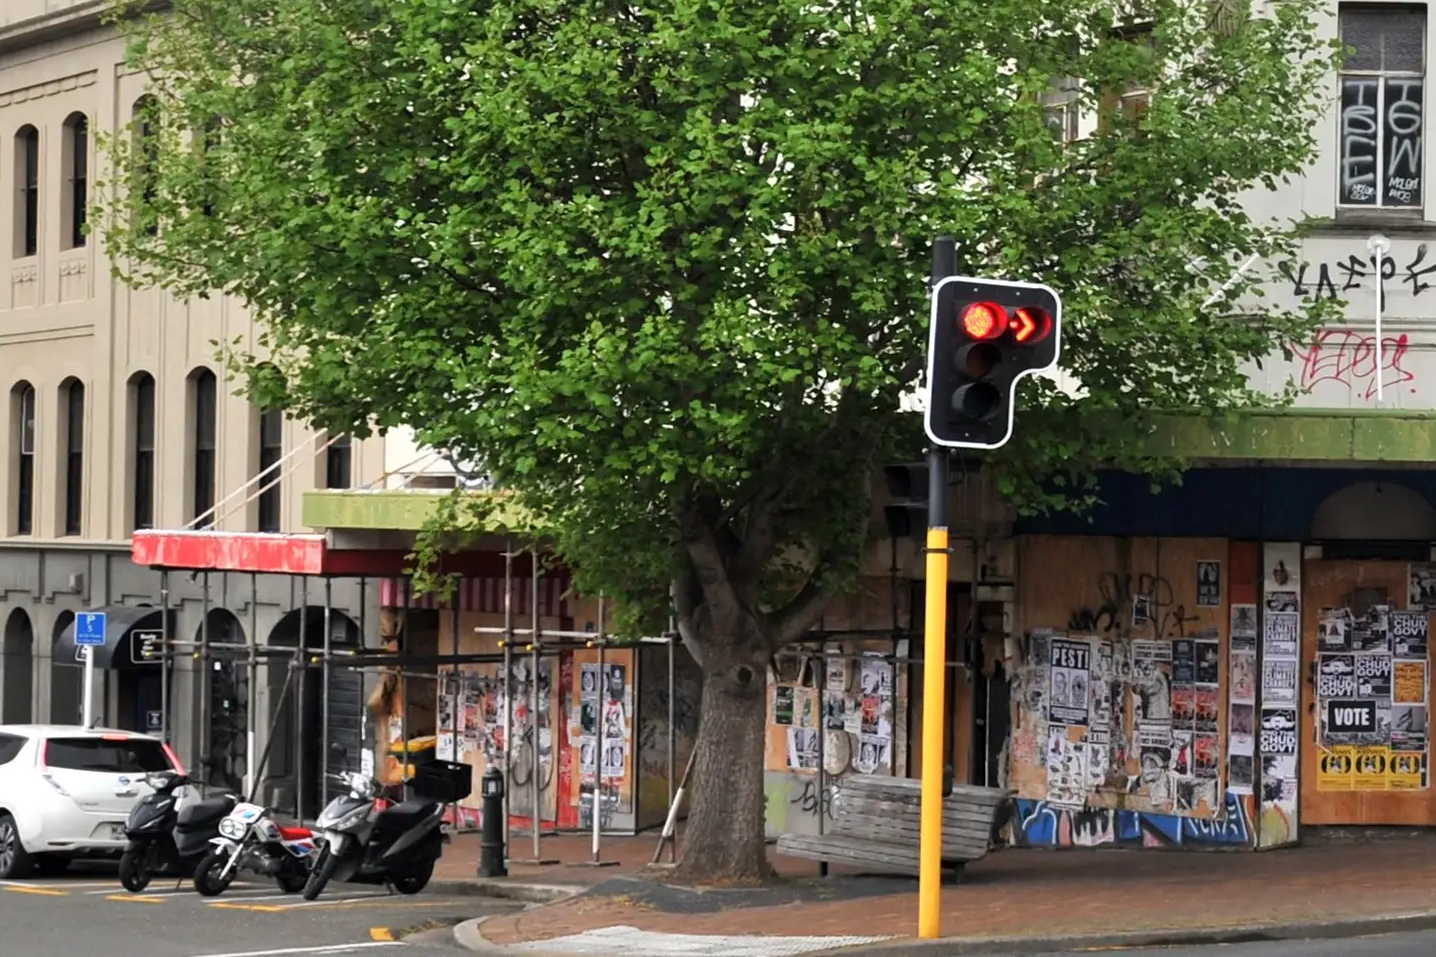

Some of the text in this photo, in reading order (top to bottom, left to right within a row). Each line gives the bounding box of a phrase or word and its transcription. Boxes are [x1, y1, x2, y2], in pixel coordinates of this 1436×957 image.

[1394, 619, 1427, 628] CHUD
[1394, 627, 1427, 636] GOVT
[1051, 647, 1089, 669] PEST!
[1357, 660, 1390, 669] CHUD
[1357, 668, 1390, 677] GOVT
[1334, 707, 1370, 726] VOTE
[1260, 735, 1295, 744] CHUD
[1260, 743, 1295, 753] GOVT
